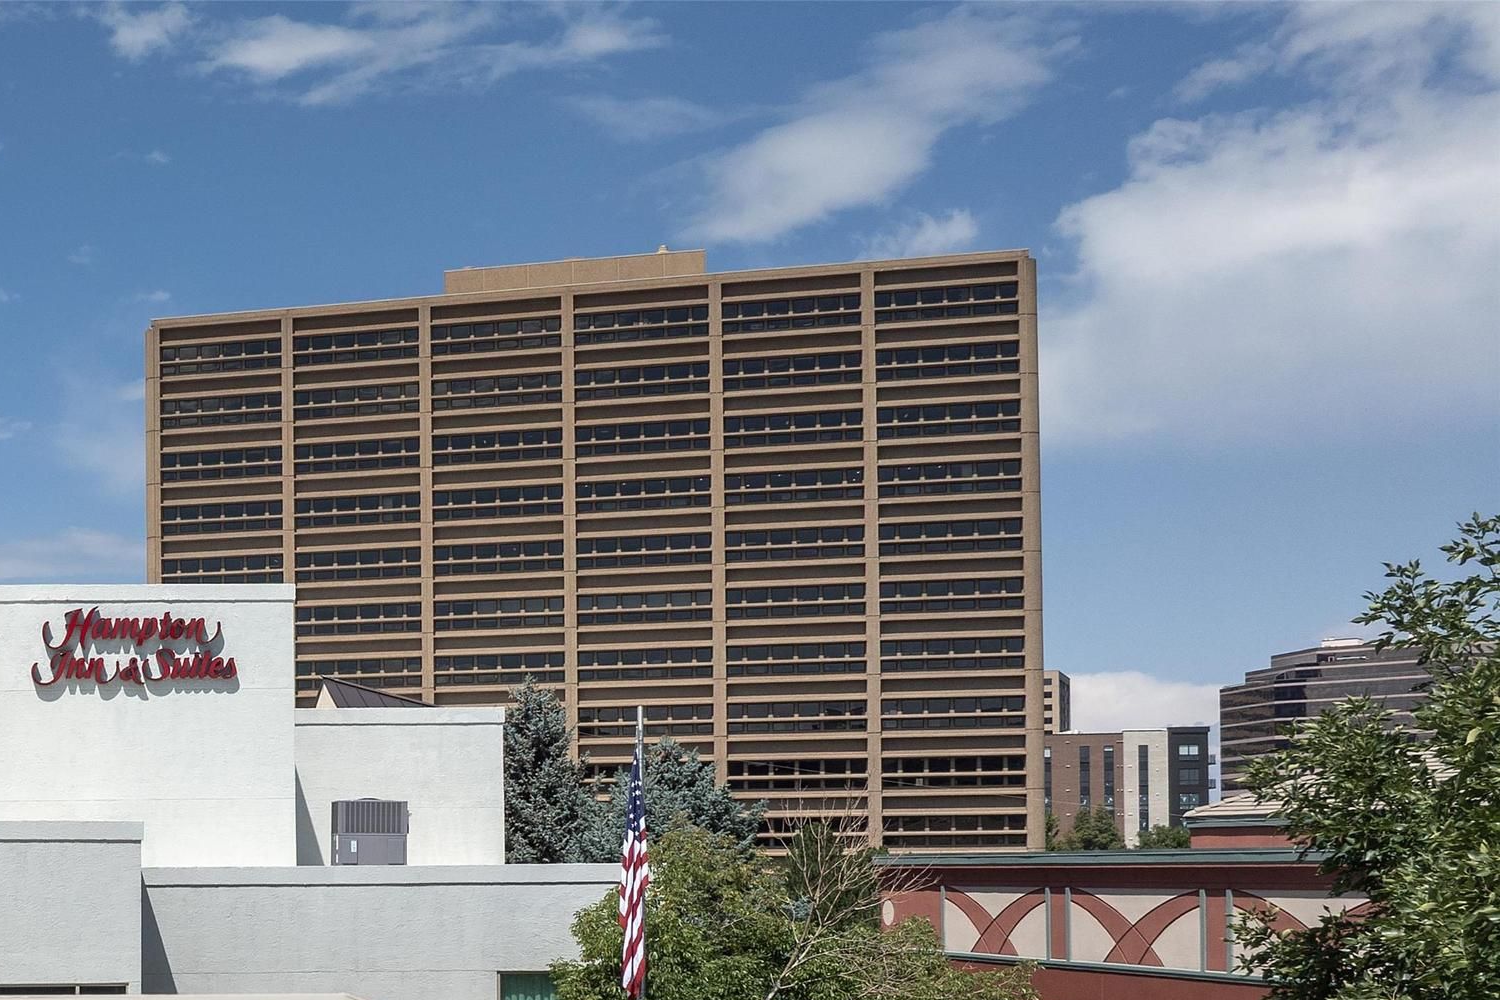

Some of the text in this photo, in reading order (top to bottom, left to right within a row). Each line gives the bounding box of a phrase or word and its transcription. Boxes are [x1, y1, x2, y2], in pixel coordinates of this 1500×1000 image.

[42, 606, 221, 650] Hampton
[31, 648, 237, 685] Inn & Suites
